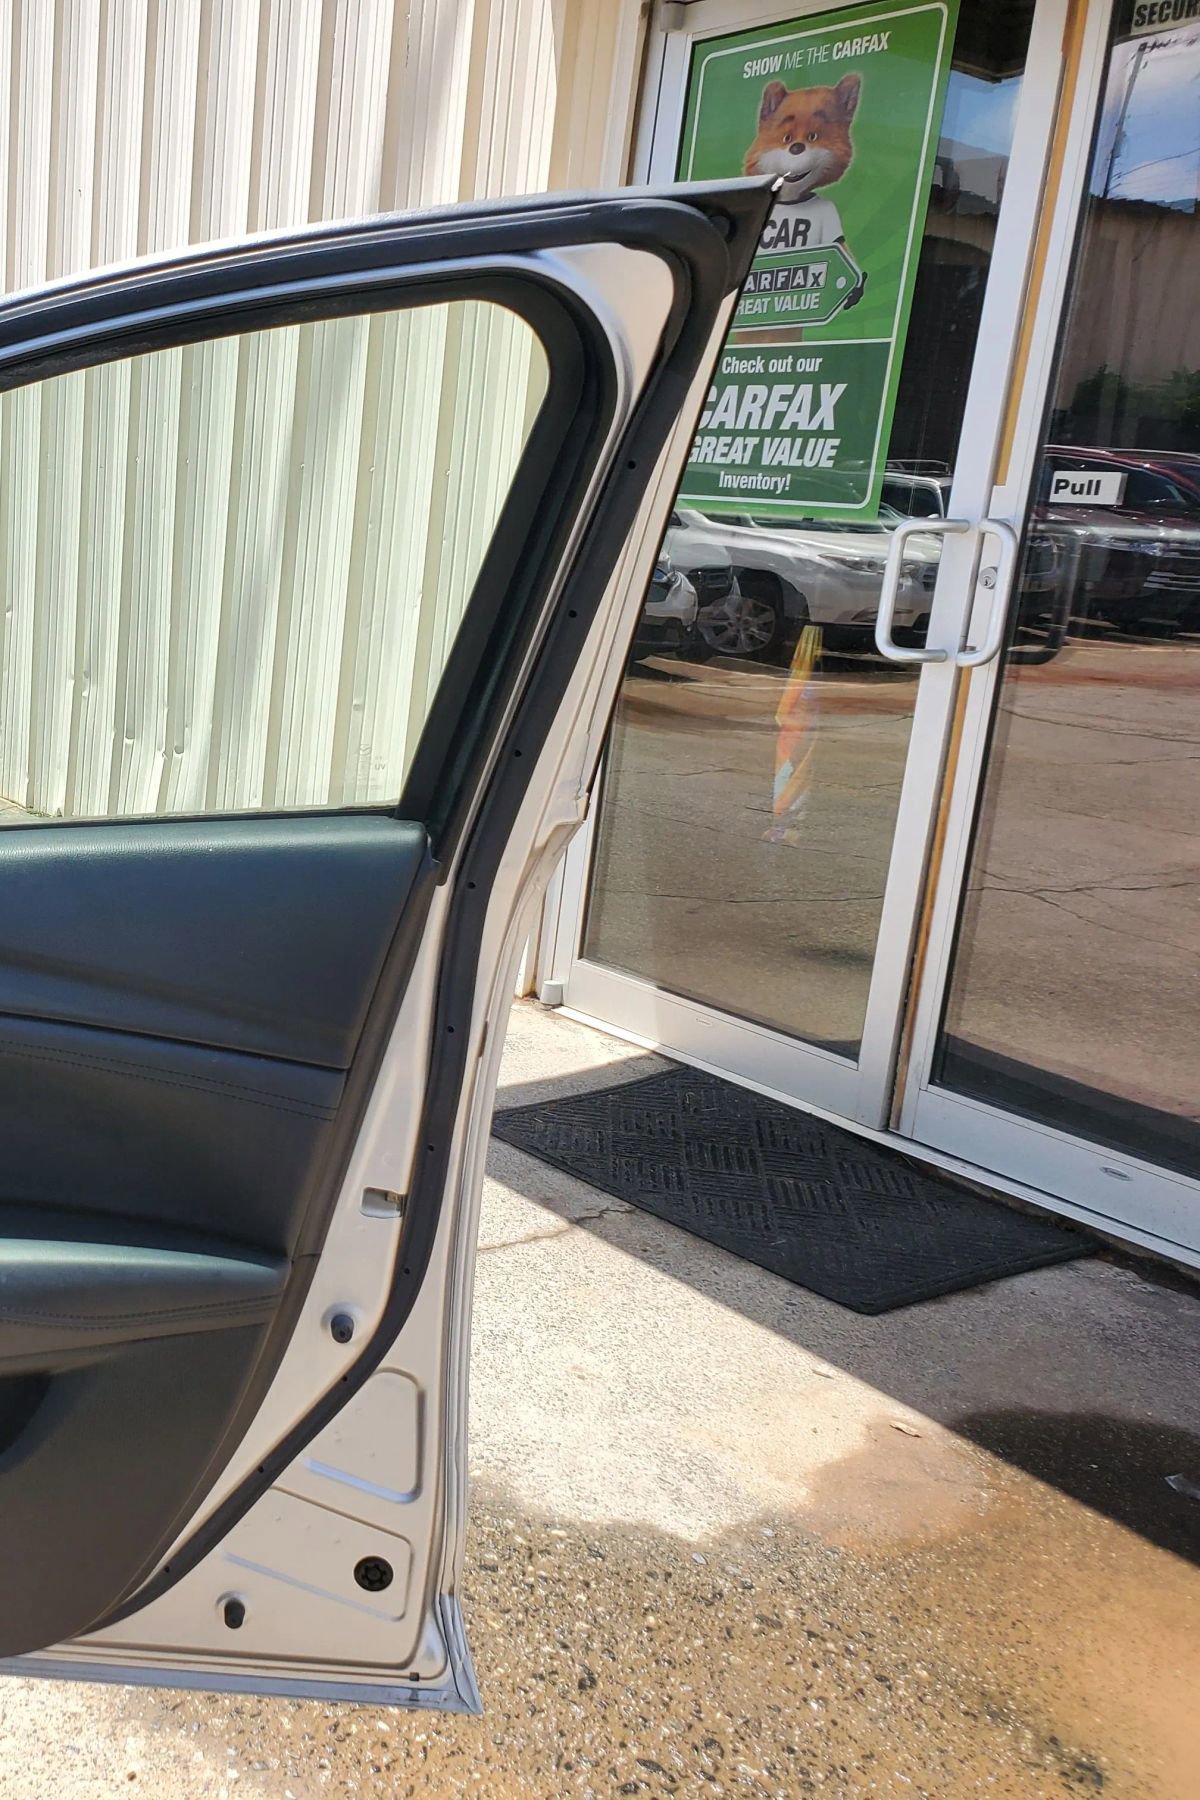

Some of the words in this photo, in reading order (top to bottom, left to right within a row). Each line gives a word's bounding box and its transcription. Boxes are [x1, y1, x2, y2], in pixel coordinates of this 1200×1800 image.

[743, 54, 783, 78] SHOW
[784, 49, 805, 70] ME
[807, 44, 831, 65] THE
[832, 31, 891, 60] CARFAX
[760, 218, 812, 249] CAR
[744, 267, 825, 292] ARFAX
[736, 297, 771, 315] REAT
[774, 293, 820, 312] VALUE
[722, 356, 765, 374] Check
[768, 355, 793, 373] out
[796, 357, 823, 373] our
[761, 437, 841, 468] VALUE
[719, 471, 791, 494] Inventory!
[1053, 478, 1102, 496] Pull
